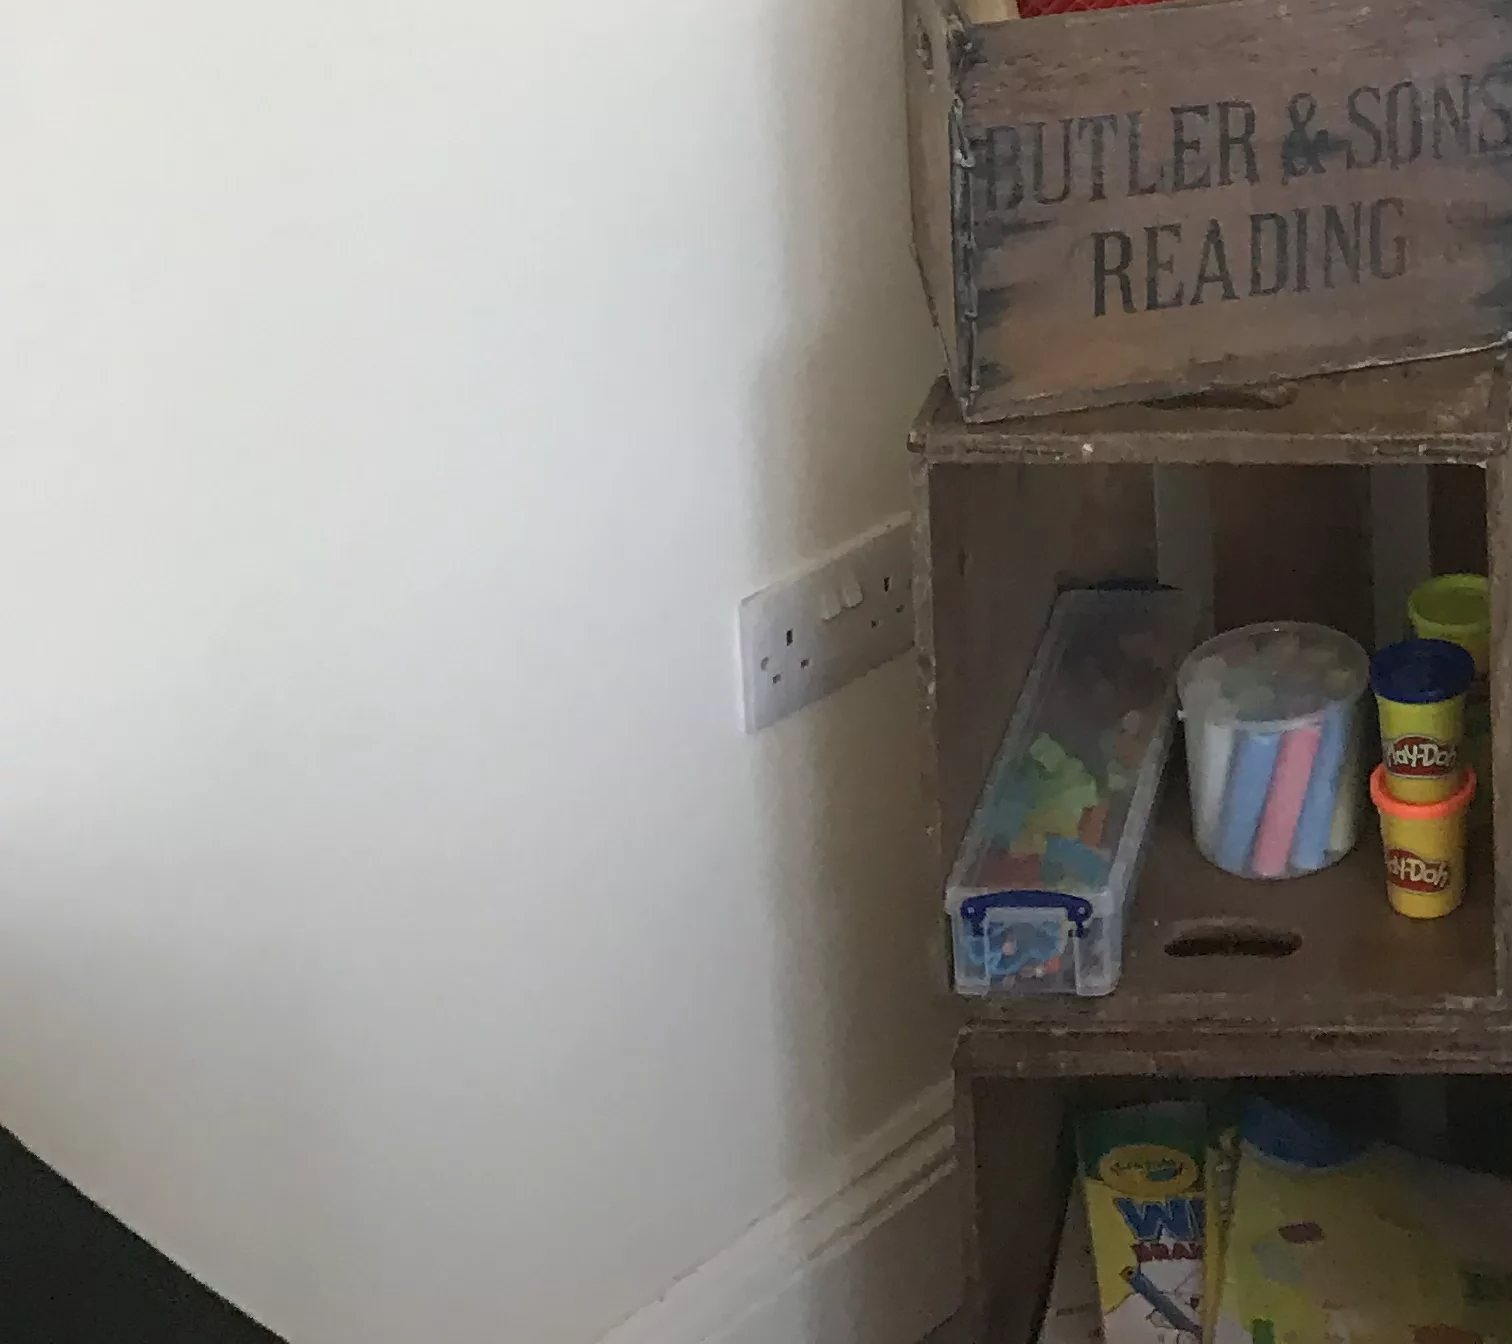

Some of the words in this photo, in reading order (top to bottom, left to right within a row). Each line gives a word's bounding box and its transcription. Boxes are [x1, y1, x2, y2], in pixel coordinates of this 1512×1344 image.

[982, 98, 1261, 212] BUTLER
[1280, 92, 1337, 185] &
[1088, 196, 1410, 318] READING
